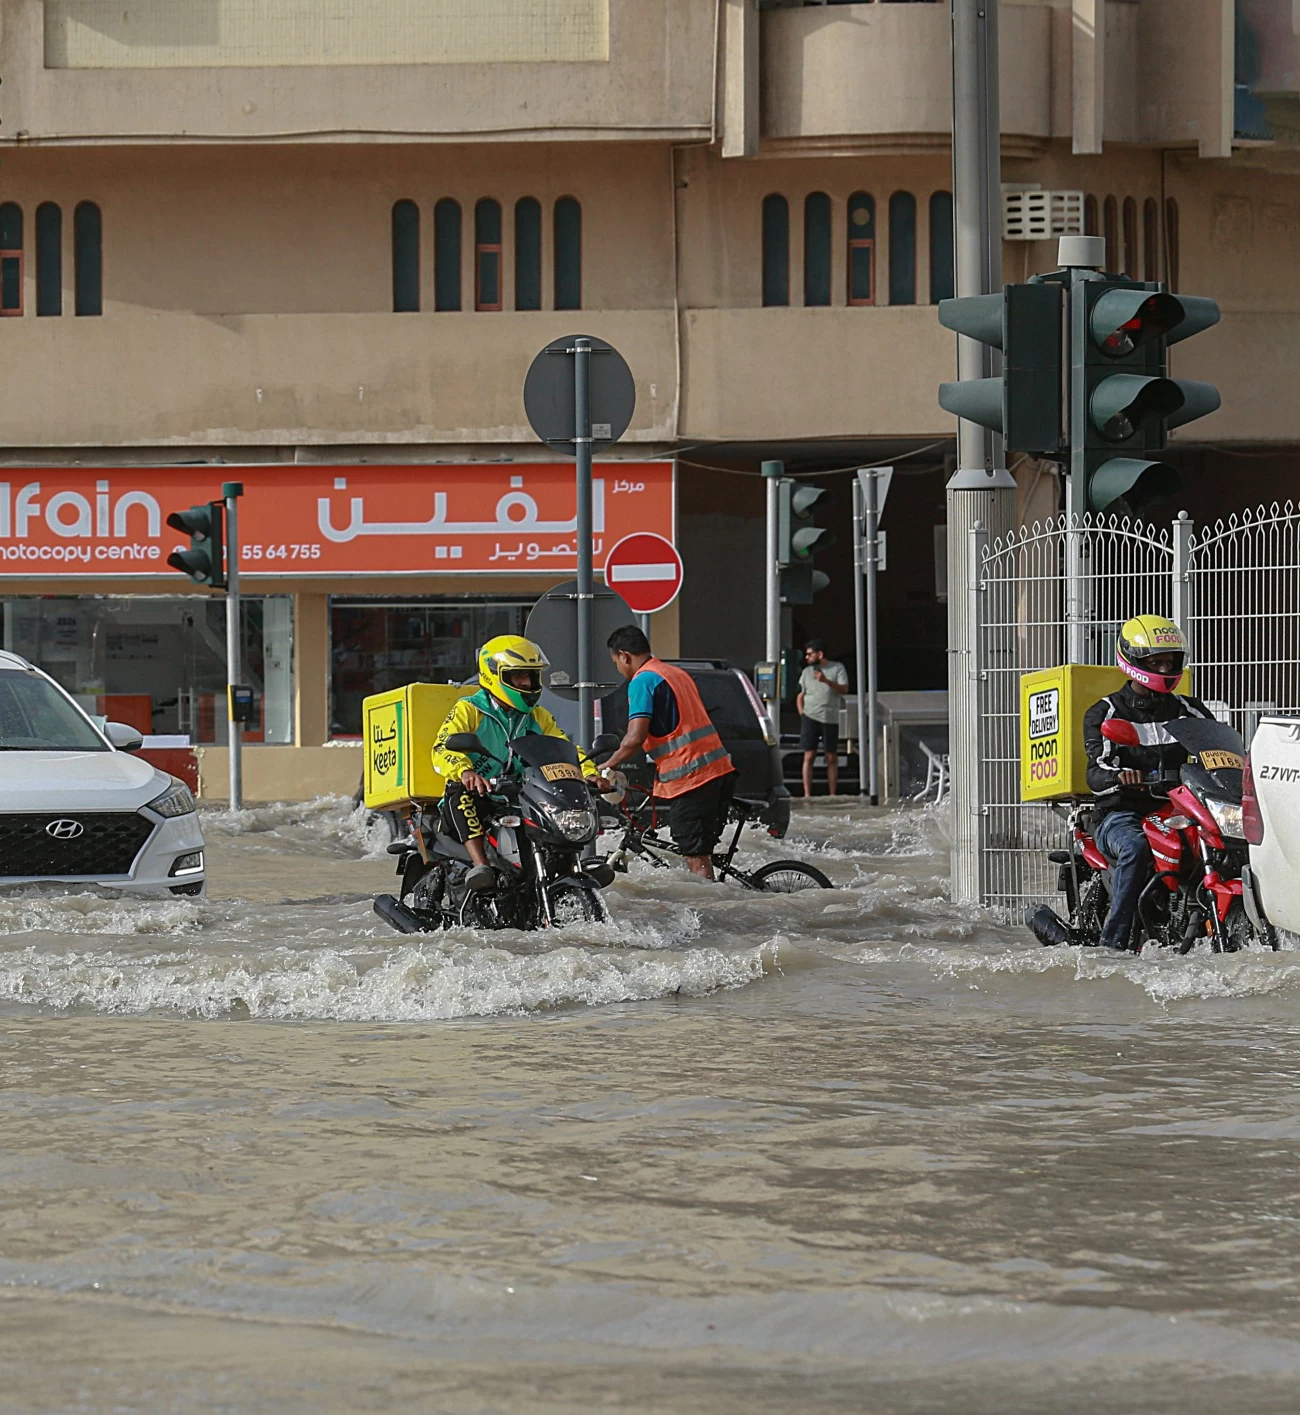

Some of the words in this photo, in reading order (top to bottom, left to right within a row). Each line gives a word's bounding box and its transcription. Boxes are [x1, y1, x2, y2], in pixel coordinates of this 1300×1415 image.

[612, 479, 645, 494] مركز
[94, 543, 161, 560] centre
[242, 545, 262, 559] 55
[265, 545, 287, 559] 64
[290, 544, 321, 559] 755
[1152, 627, 1182, 636] noon
[1155, 634, 1183, 644] FOOD
[1126, 667, 1150, 684] FOOD
[1036, 693, 1052, 715] FREE
[373, 720, 396, 748] كيتا
[1031, 714, 1057, 735] DELIVERY
[1030, 738, 1058, 761] noon
[373, 746, 397, 775] keeta
[1030, 757, 1058, 782] FOOD
[456, 794, 484, 839] keeta
